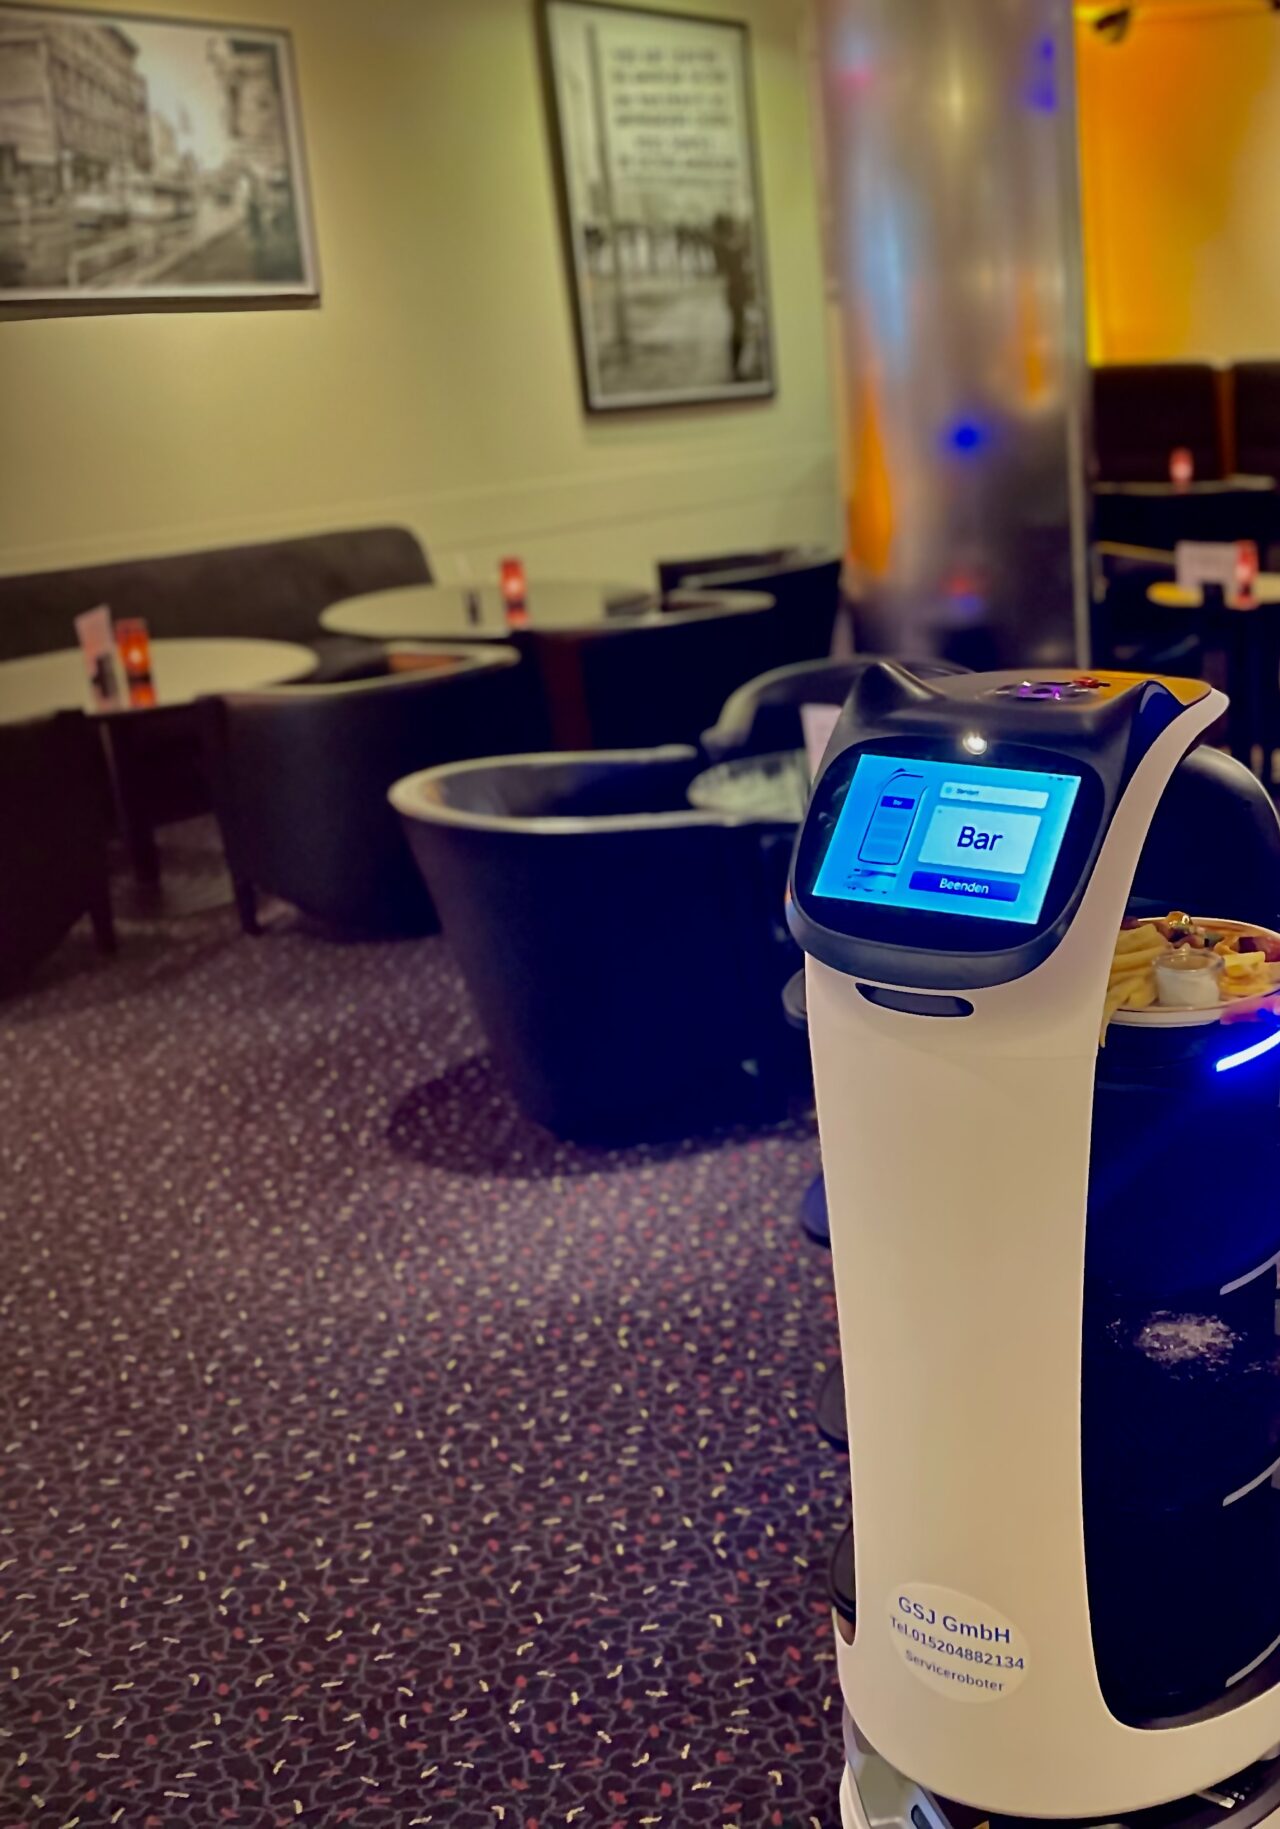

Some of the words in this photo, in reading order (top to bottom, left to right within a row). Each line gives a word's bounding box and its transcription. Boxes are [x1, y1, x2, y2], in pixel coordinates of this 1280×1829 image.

[957, 826, 1003, 851] Bar
[939, 878, 989, 894] Beenden
[898, 1596, 936, 1625] GSJ
[942, 1615, 1010, 1643] GmbH
[905, 1649, 1005, 1691] Serviceroboter
